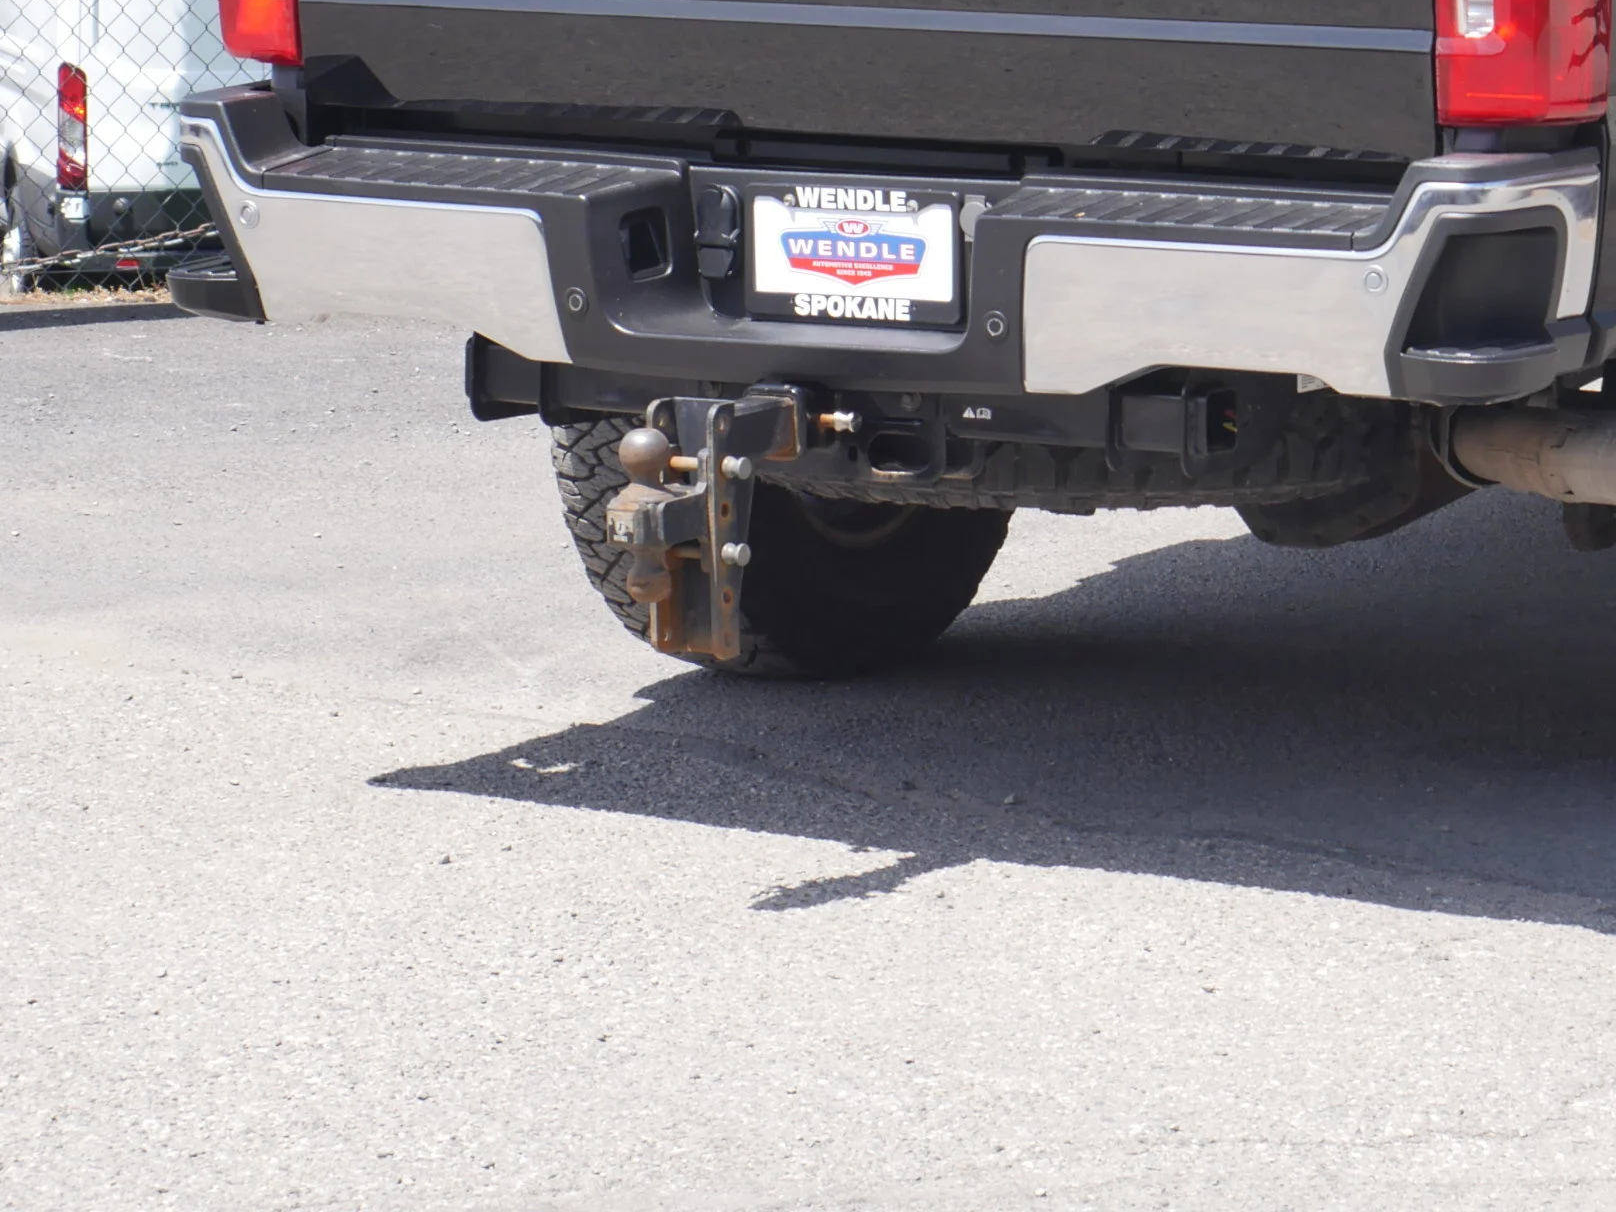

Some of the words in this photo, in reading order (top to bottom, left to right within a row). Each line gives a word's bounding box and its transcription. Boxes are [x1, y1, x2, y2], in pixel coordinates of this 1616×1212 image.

[796, 186, 907, 213] WENDLE
[842, 222, 865, 235] W
[788, 238, 916, 261] WENDLE
[812, 260, 852, 269] AUTOMOTIVE
[794, 293, 911, 321] SPOKANE
